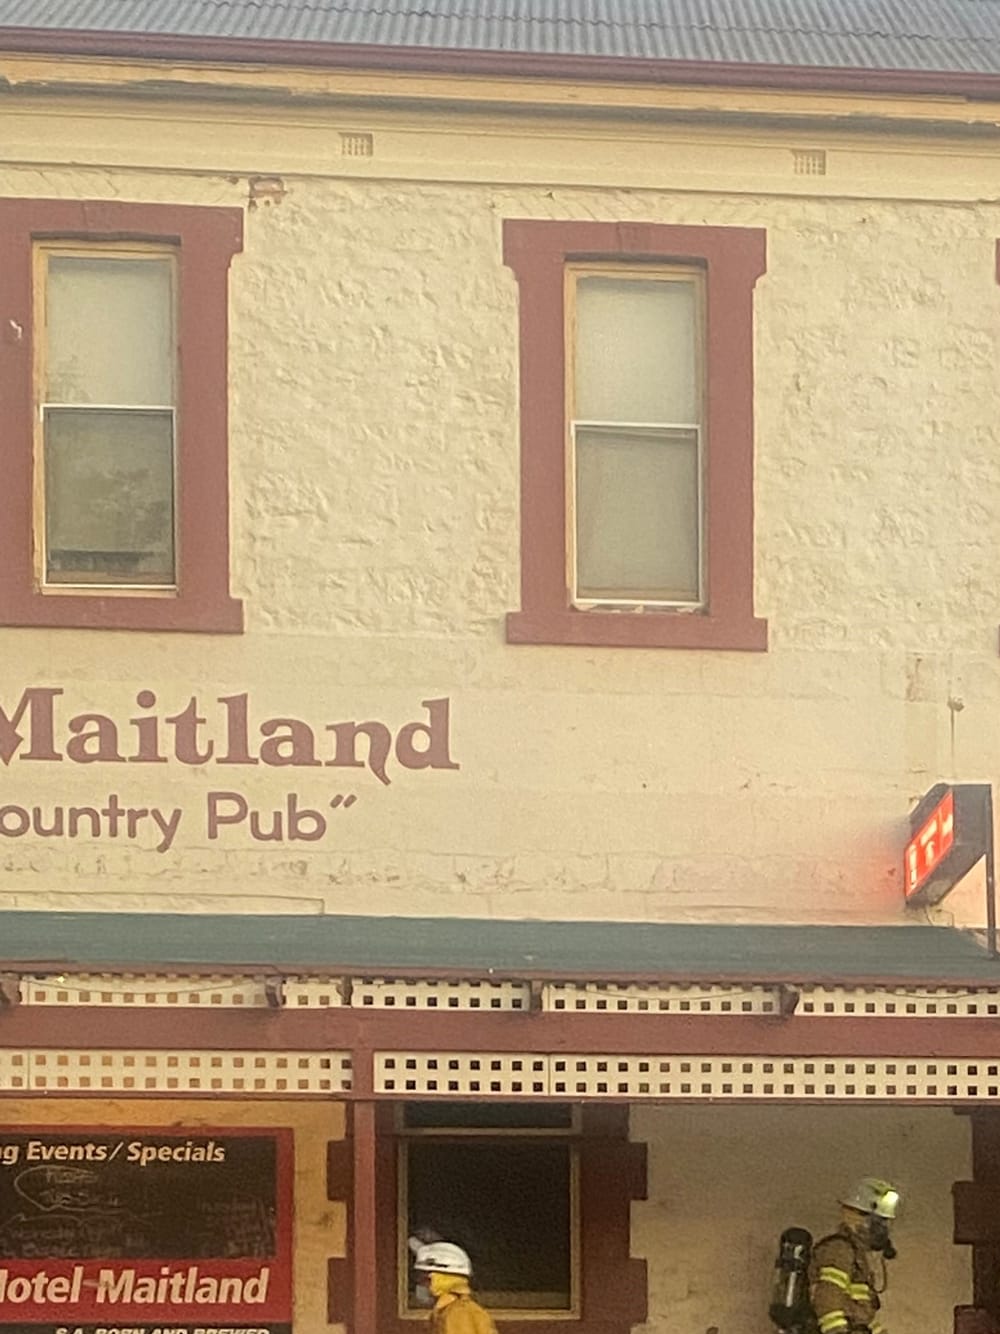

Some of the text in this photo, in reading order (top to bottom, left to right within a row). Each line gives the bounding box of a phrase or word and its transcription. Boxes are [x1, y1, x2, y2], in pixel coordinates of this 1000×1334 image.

[0, 687, 460, 786] Maitland
[127, 1141, 226, 1166] Specials
[96, 1267, 270, 1304] Maitland
